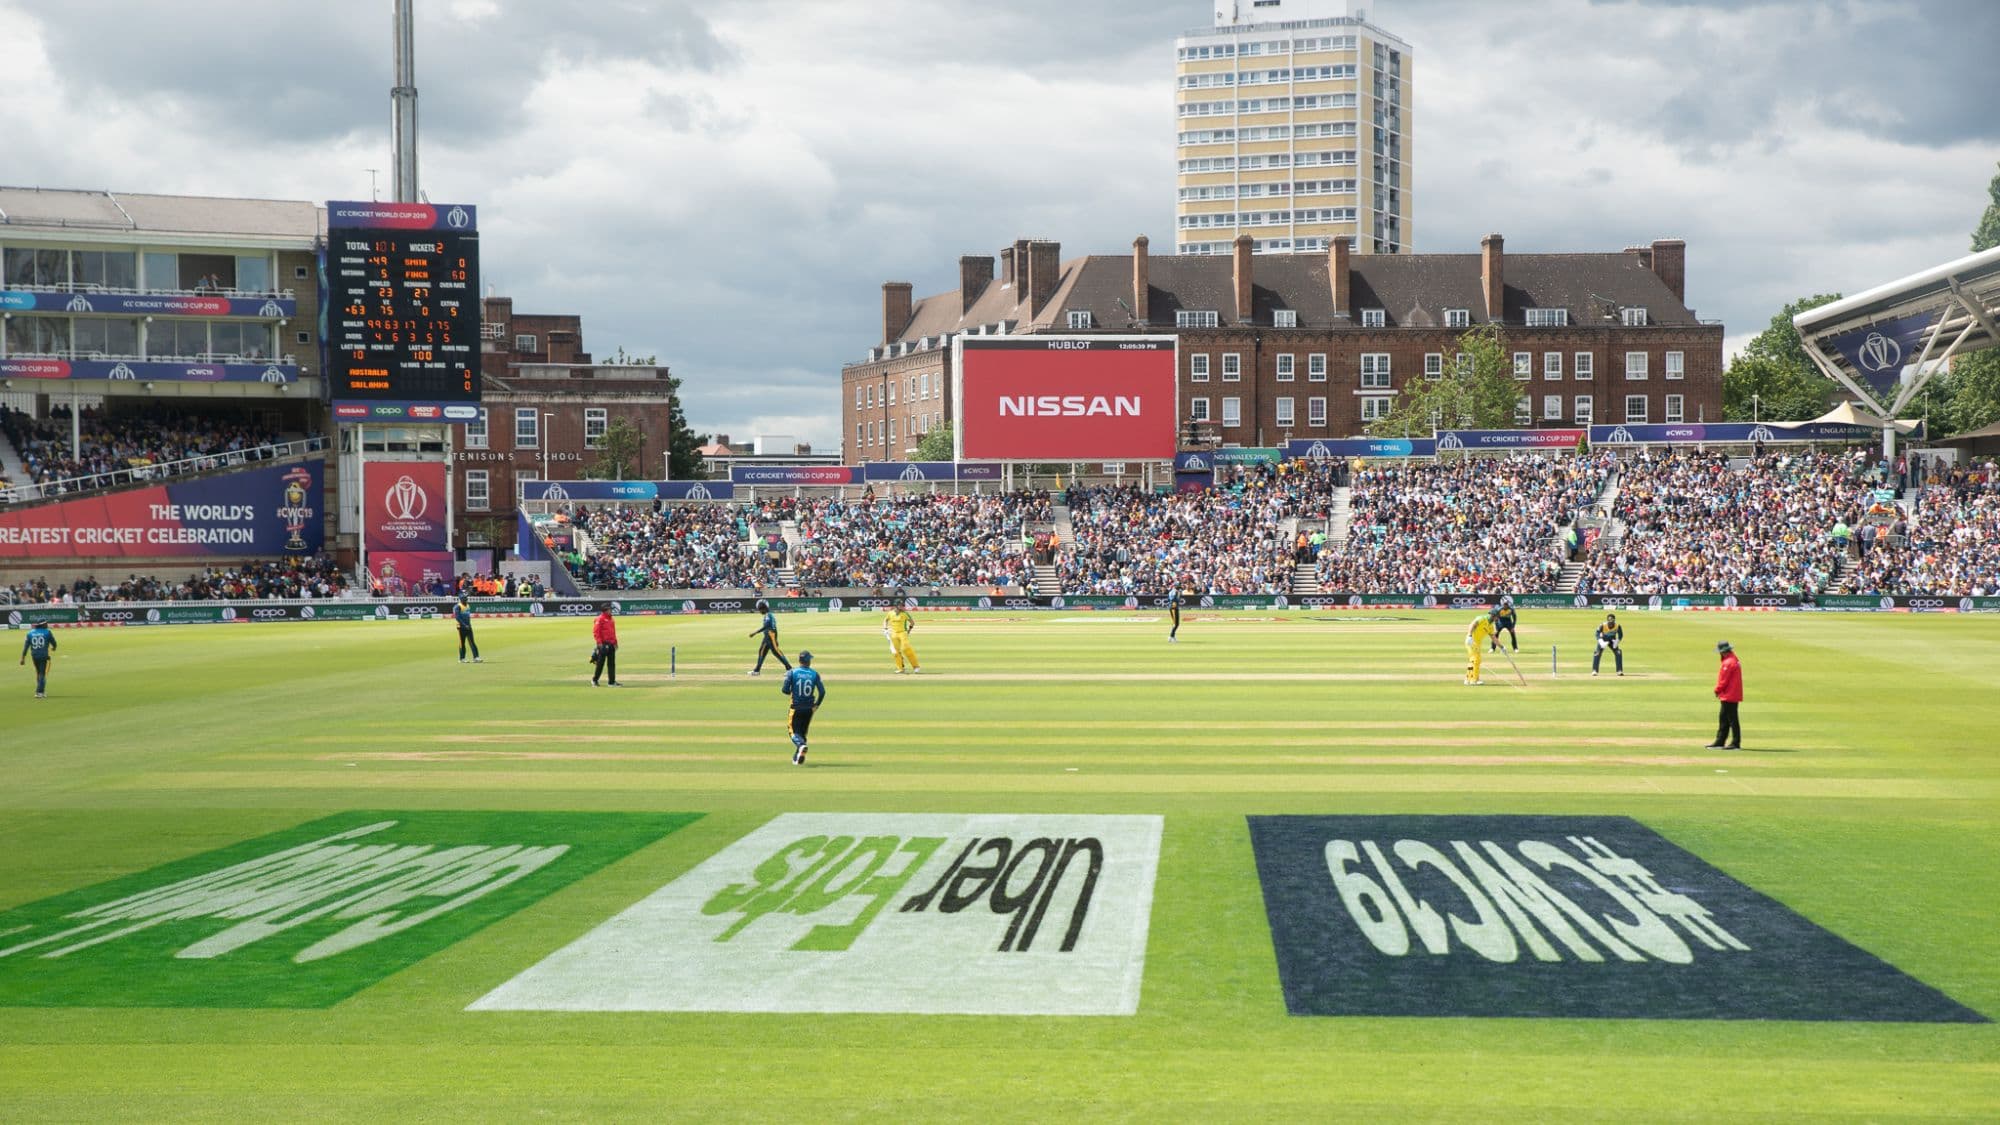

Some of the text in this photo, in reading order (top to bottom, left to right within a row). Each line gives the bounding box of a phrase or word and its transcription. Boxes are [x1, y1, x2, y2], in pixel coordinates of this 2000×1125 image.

[375, 211, 399, 219] WORLD
[345, 242, 370, 251] TOTAL
[409, 244, 435, 252] WICKETS
[436, 243, 444, 254] 2
[373, 256, 388, 265] 49
[459, 258, 465, 268] 0
[381, 269, 387, 278] 5
[405, 271, 428, 279] FINCH
[452, 271, 465, 280] 60
[379, 288, 393, 297] 23
[414, 288, 428, 298] 27
[351, 305, 366, 315] 63
[380, 306, 394, 315] 75
[422, 306, 429, 316] 0
[450, 307, 457, 317] 5
[375, 333, 450, 343] 4 6 3 5 5
[1048, 341, 1091, 350] HUBLOT
[353, 350, 364, 360] 10
[413, 351, 432, 360] 100
[349, 368, 388, 376] AUSTRALIA
[464, 369, 471, 379] 0
[464, 381, 471, 391] 0
[999, 396, 1141, 416] NISSAN
[535, 452, 582, 461] SCHOOL
[149, 504, 254, 521] THE WORLD'S
[277, 507, 313, 518] #CWC19
[74, 527, 144, 544] CRICKET
[147, 527, 254, 544] CELEBRATION
[395, 530, 418, 539] 2019
[709, 600, 742, 610] oppo
[858, 599, 890, 607] oppo
[1301, 597, 1334, 605] oppo
[1452, 597, 1485, 606] oppo
[1601, 597, 1634, 606] oppo
[1753, 597, 1787, 606] oppo
[1909, 599, 1944, 608] oppo
[403, 606, 438, 615] oppo
[560, 603, 593, 612] oppo
[102, 612, 134, 621] oppo
[253, 609, 286, 618] oppo
[31, 636, 45, 649] 99
[795, 679, 813, 696] 16
[700, 834, 1104, 953] Uber Eats
[1323, 835, 1752, 964] #CWC19
